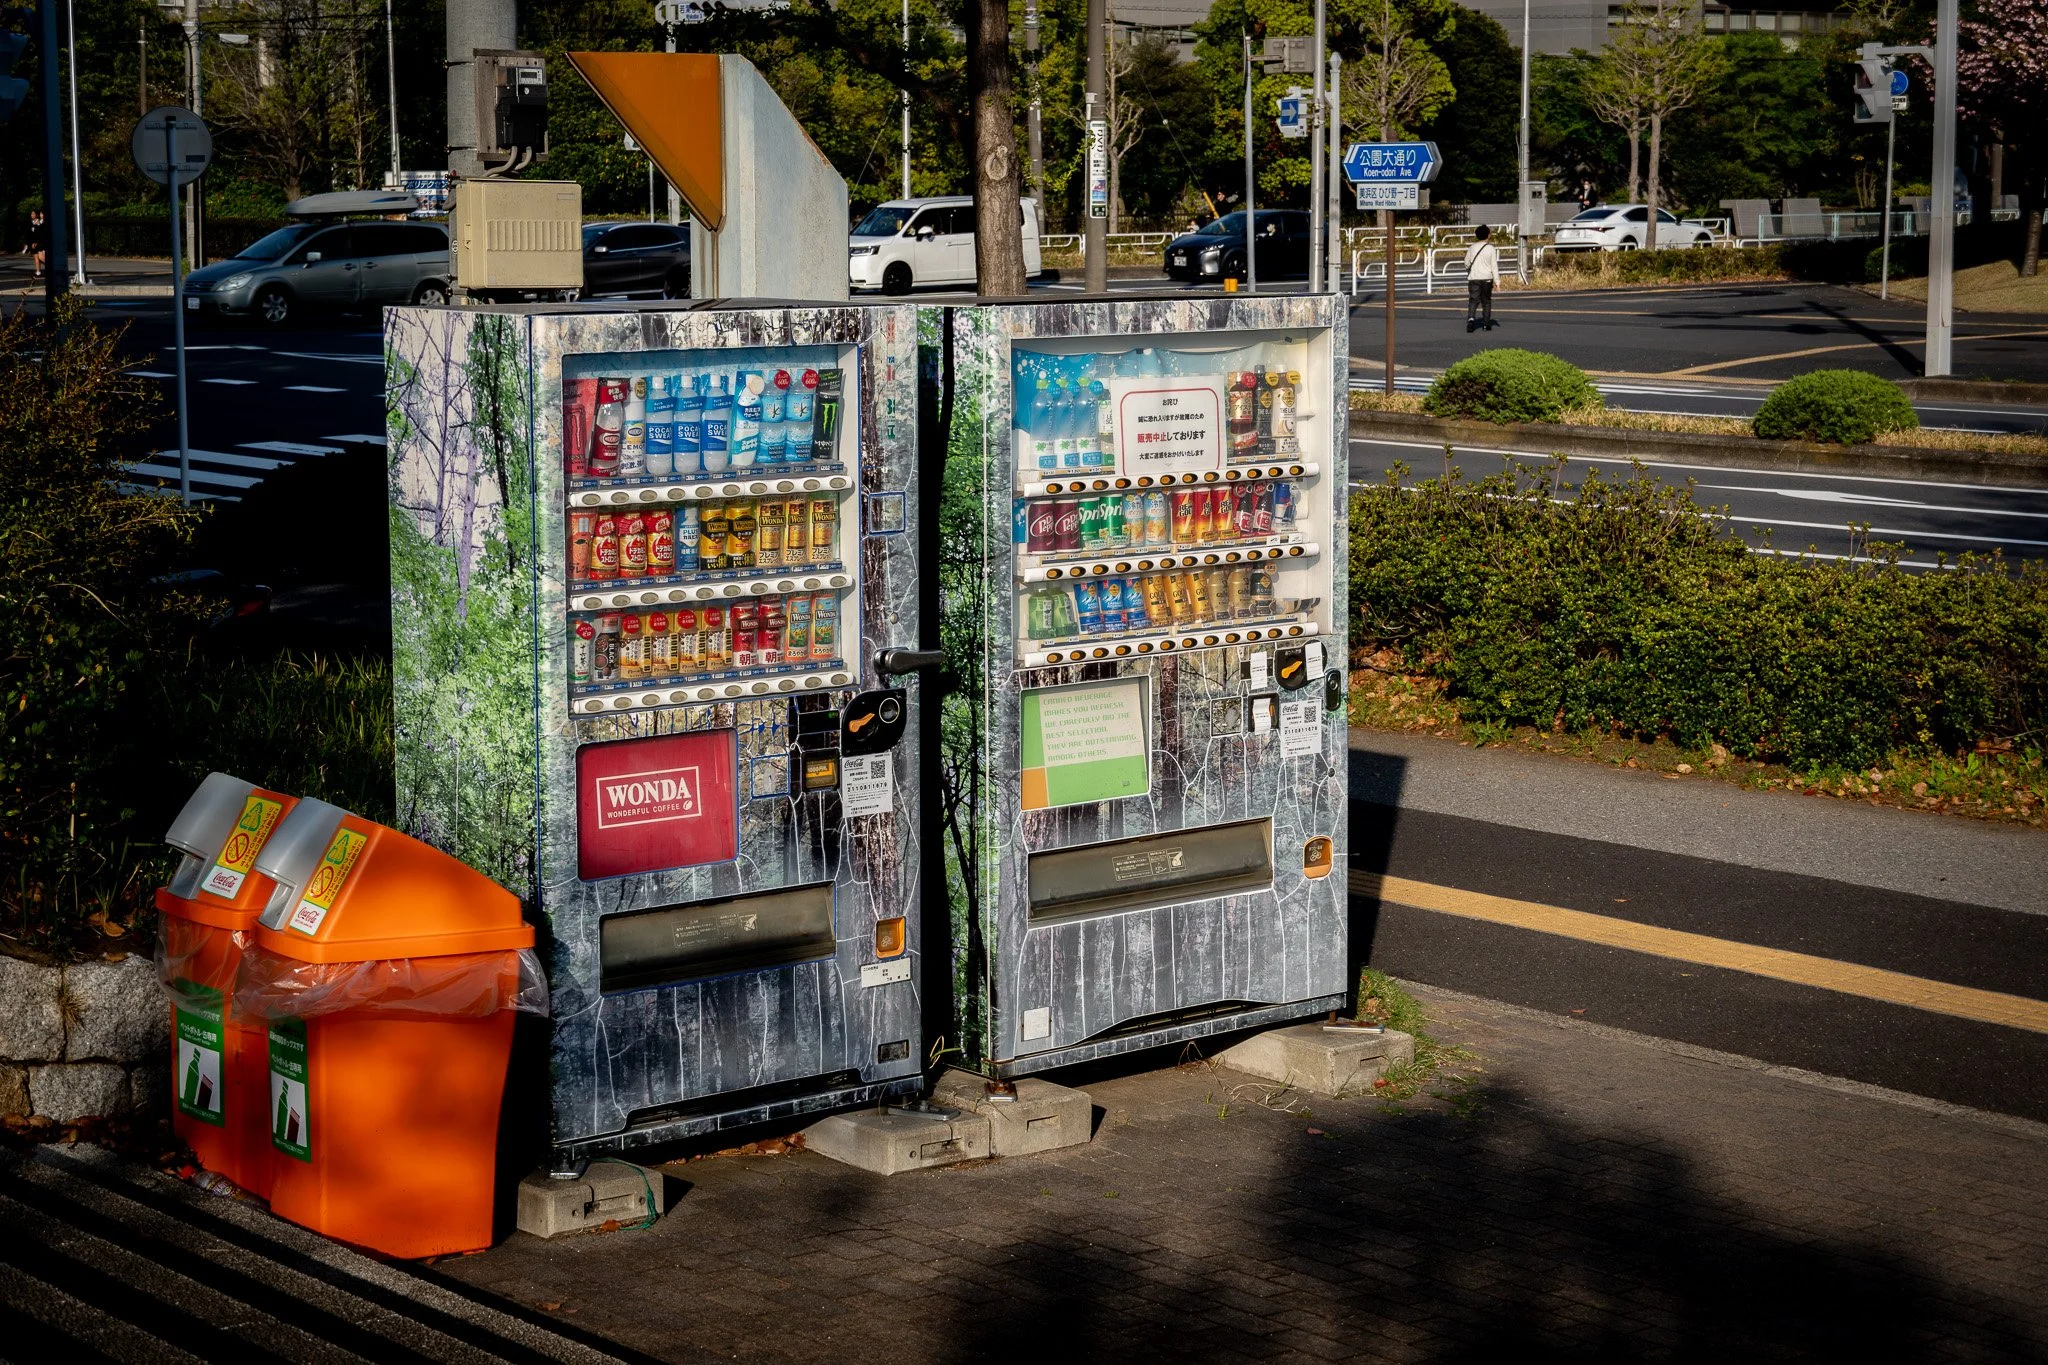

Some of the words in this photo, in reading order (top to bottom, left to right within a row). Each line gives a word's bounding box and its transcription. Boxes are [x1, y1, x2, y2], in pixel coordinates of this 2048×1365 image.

[1360, 149, 1417, 167] 公園大通り
[1363, 168, 1397, 177] Koen-odori
[1400, 168, 1413, 177] Ave.
[1379, 187, 1416, 199] ひび野一丁目
[1162, 398, 1178, 406] お詫び
[1138, 413, 1205, 423] 誠に恐れ入りますが故障のため
[1137, 430, 1206, 443] 販売中止しております
[1139, 449, 1205, 460] 大変ご迷惑をおかけいたします
[761, 516, 784, 525] WONDA
[814, 512, 836, 521] WONDA
[792, 613, 811, 622] WONDA
[816, 610, 836, 619] WONDA
[740, 653, 751, 665] 朝
[765, 651, 777, 663] 朝
[606, 777, 692, 808] WONDA
[607, 807, 650, 819] WONDERFUL
[652, 803, 680, 813] COFFEE
